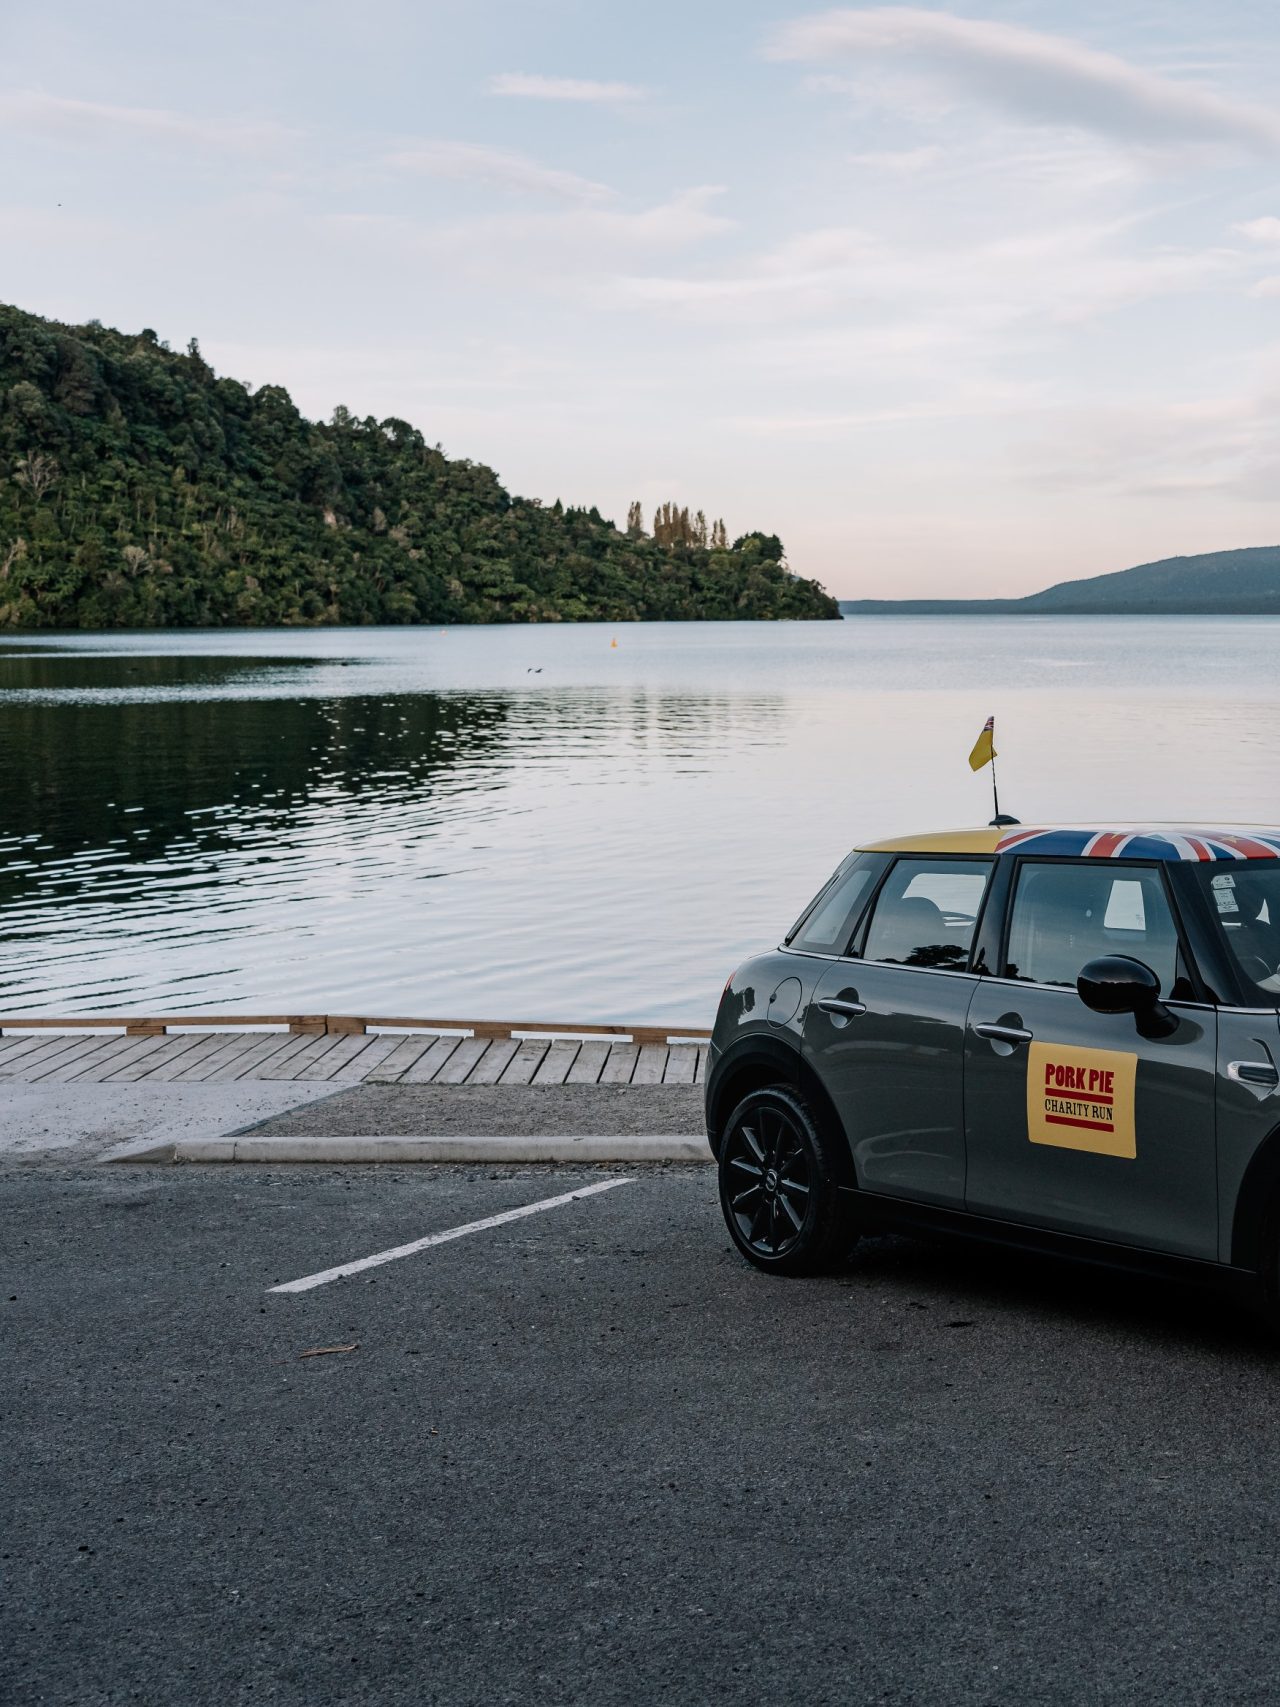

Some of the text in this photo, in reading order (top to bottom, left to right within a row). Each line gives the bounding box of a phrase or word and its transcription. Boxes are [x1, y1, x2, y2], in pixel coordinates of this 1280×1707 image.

[1045, 1063, 1114, 1093] PORK PIE
[1045, 1099, 1113, 1120] CHARITY RUN
